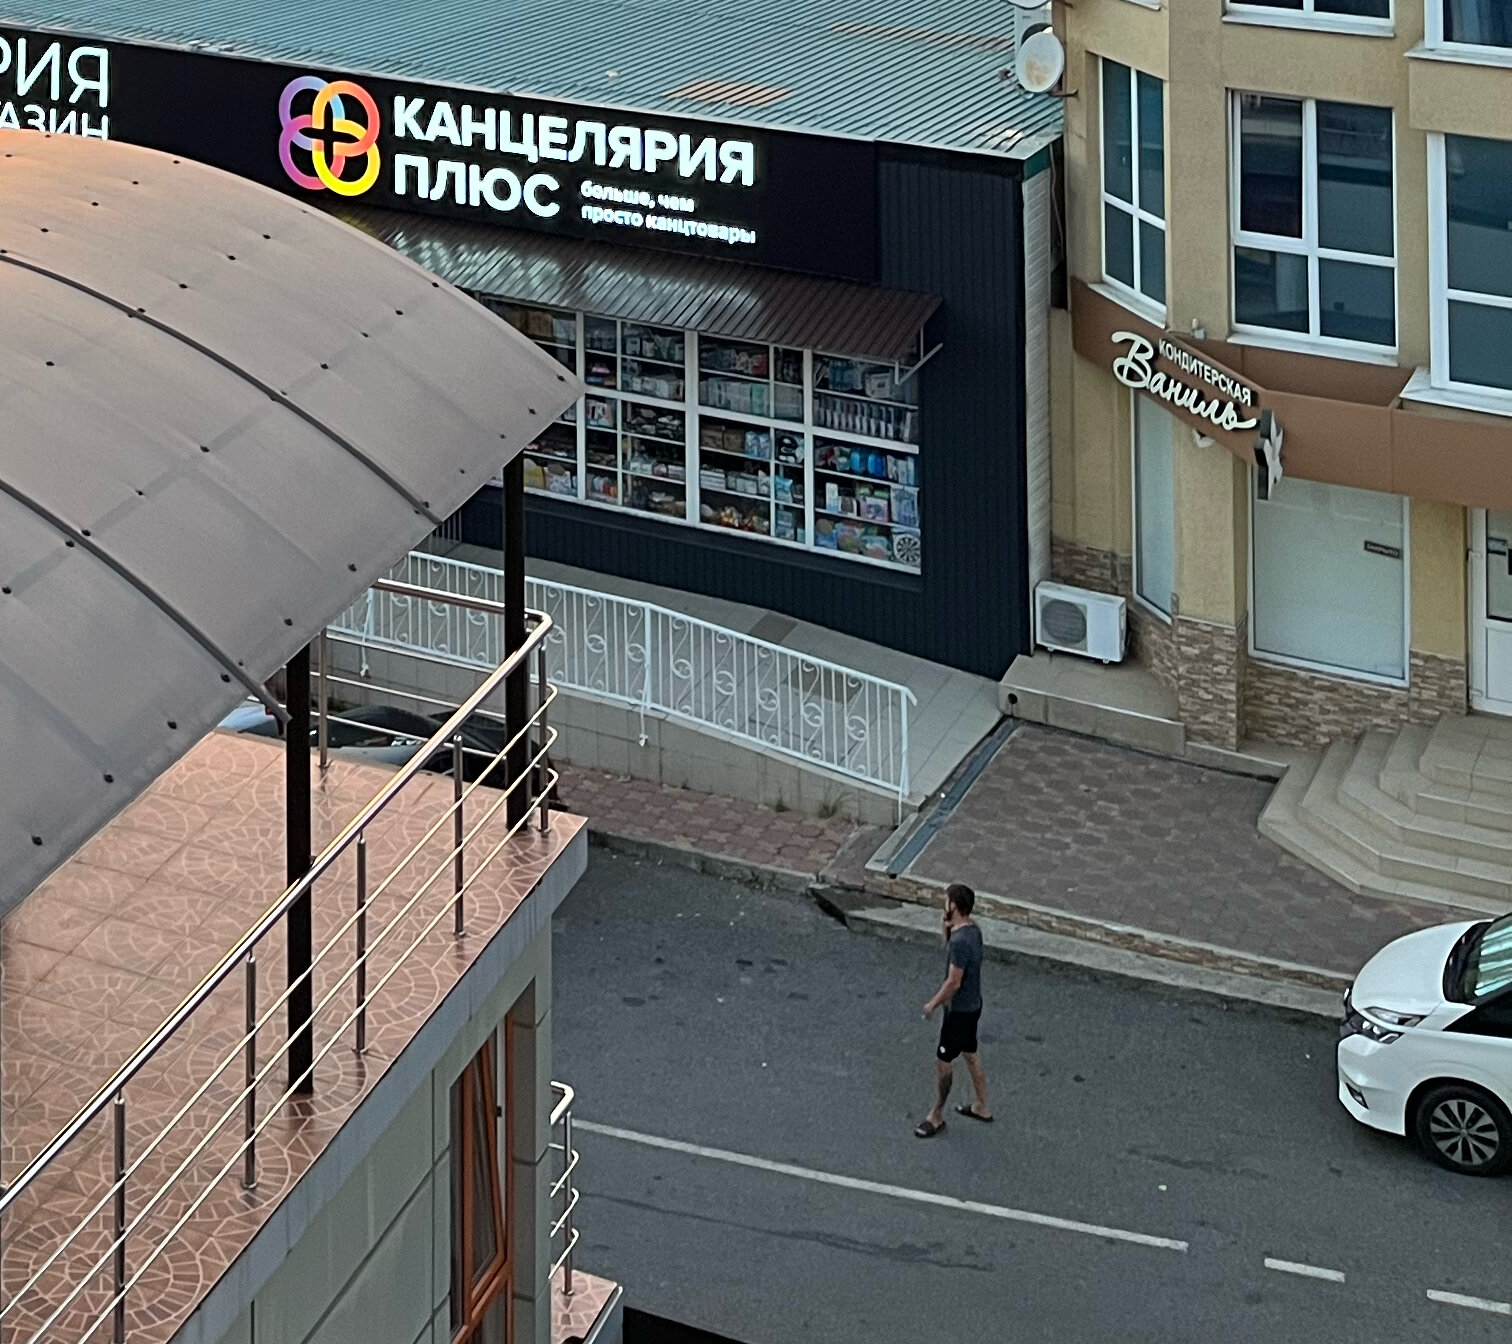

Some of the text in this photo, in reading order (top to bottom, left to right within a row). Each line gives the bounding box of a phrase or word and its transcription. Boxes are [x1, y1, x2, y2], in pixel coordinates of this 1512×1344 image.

[394, 95, 756, 187] КАНЦЕЛЯРИЯ
[394, 154, 561, 218] ПЛЮС
[580, 180, 695, 213] больше, чем
[581, 205, 756, 244] просто канцтовары
[1158, 338, 1252, 407] КОНДИТЕРСКАЯ
